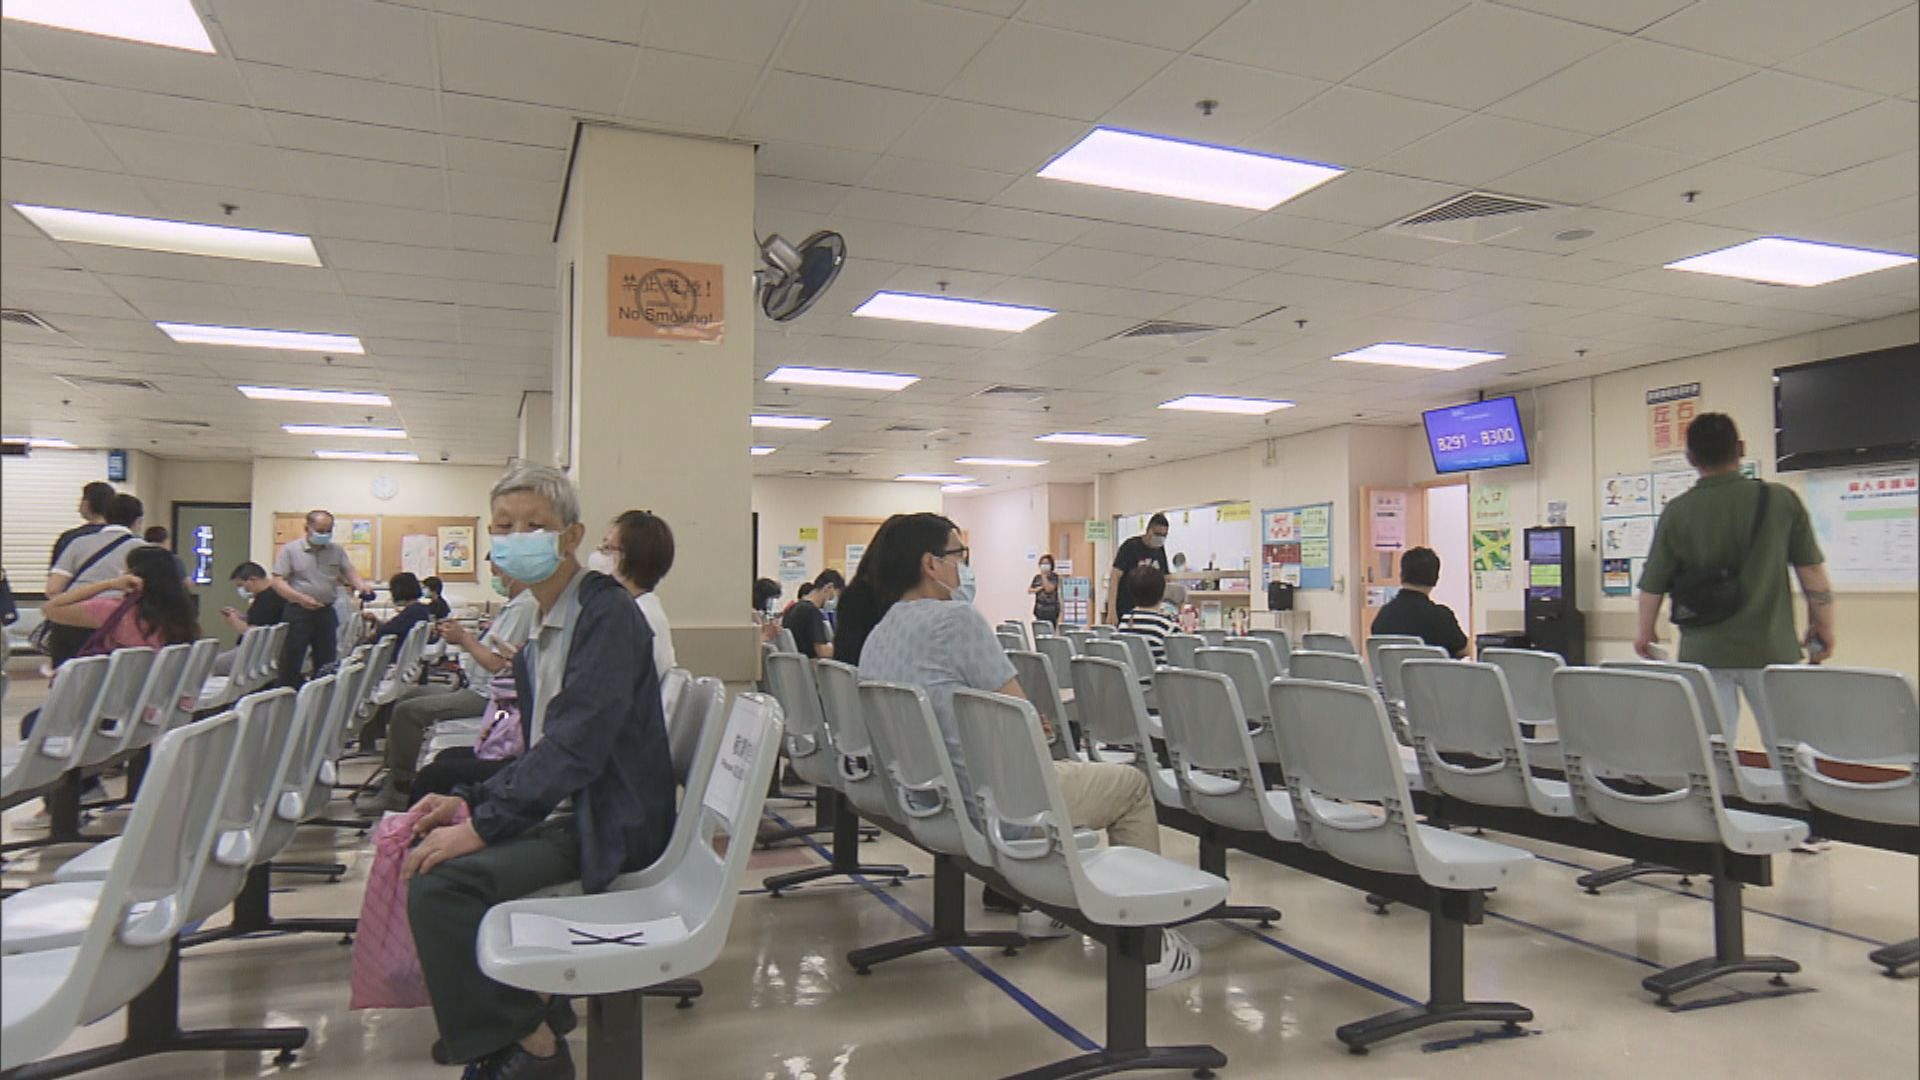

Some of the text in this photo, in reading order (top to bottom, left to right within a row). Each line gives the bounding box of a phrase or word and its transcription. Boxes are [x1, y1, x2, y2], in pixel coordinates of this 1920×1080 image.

[618, 306, 640, 320] No
[1437, 434, 1468, 451] B291
[1480, 427, 1515, 446] B300
